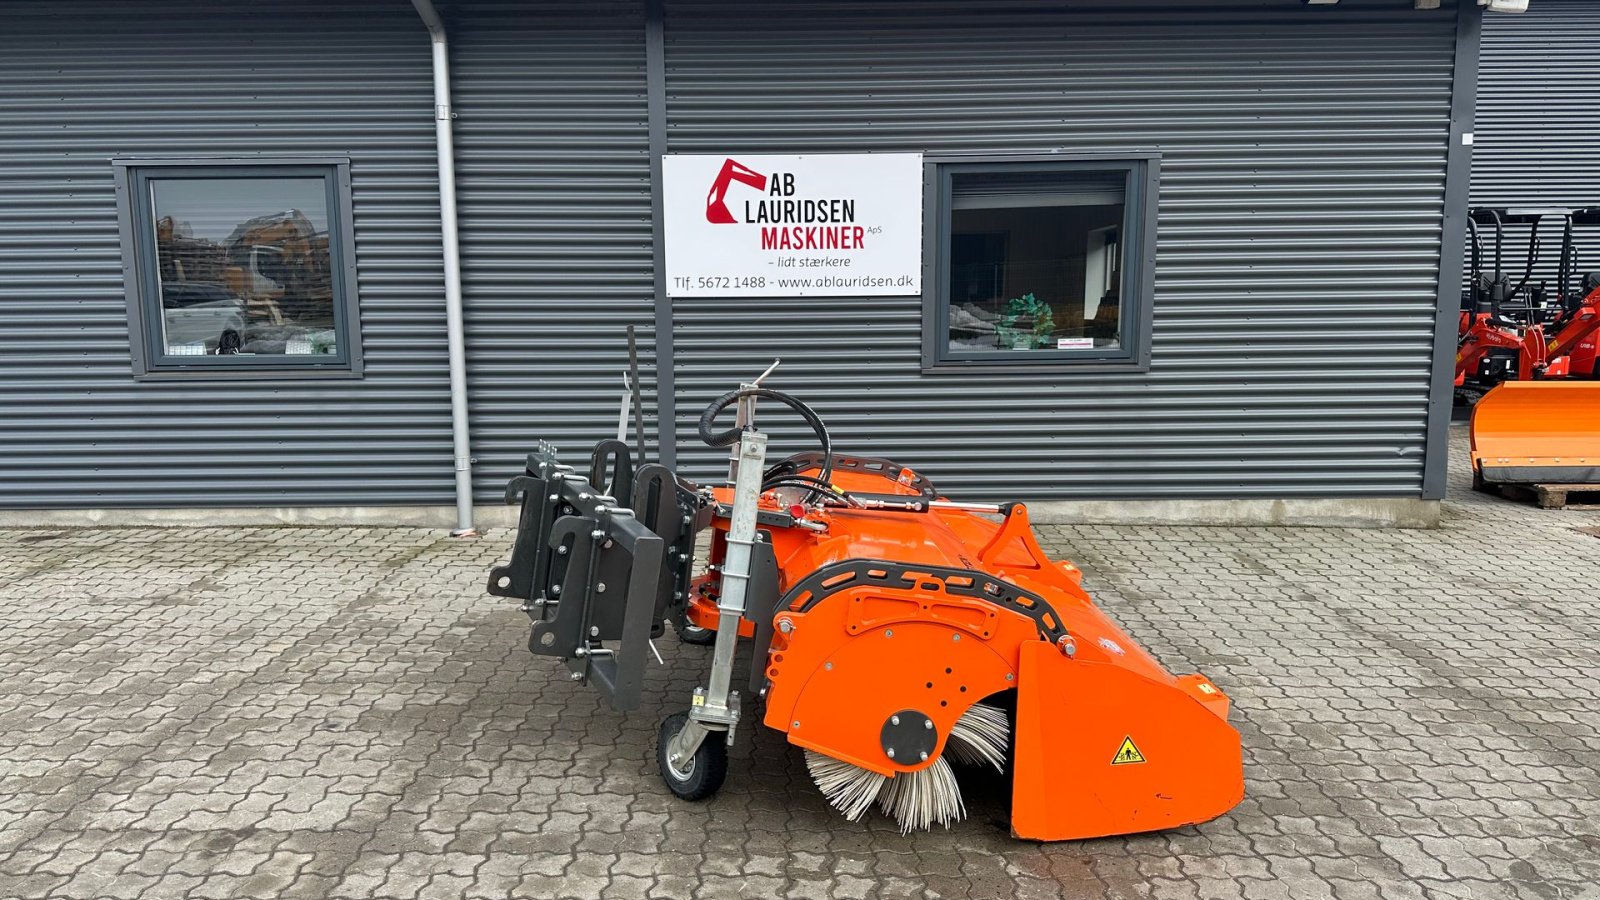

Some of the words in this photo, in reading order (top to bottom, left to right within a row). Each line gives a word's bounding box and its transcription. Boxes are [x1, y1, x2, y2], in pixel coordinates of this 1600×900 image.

[769, 172, 796, 197] AB
[744, 199, 855, 224] LAURIDSEN
[761, 226, 865, 251] MASKINER
[866, 226, 883, 235] ApS
[777, 256, 797, 268] lidt
[798, 256, 851, 268] stærkere
[673, 276, 694, 291] Tlf.
[698, 276, 731, 289] 5672
[734, 276, 767, 289] 1488
[777, 275, 914, 289] www.ablauridsen.dk
